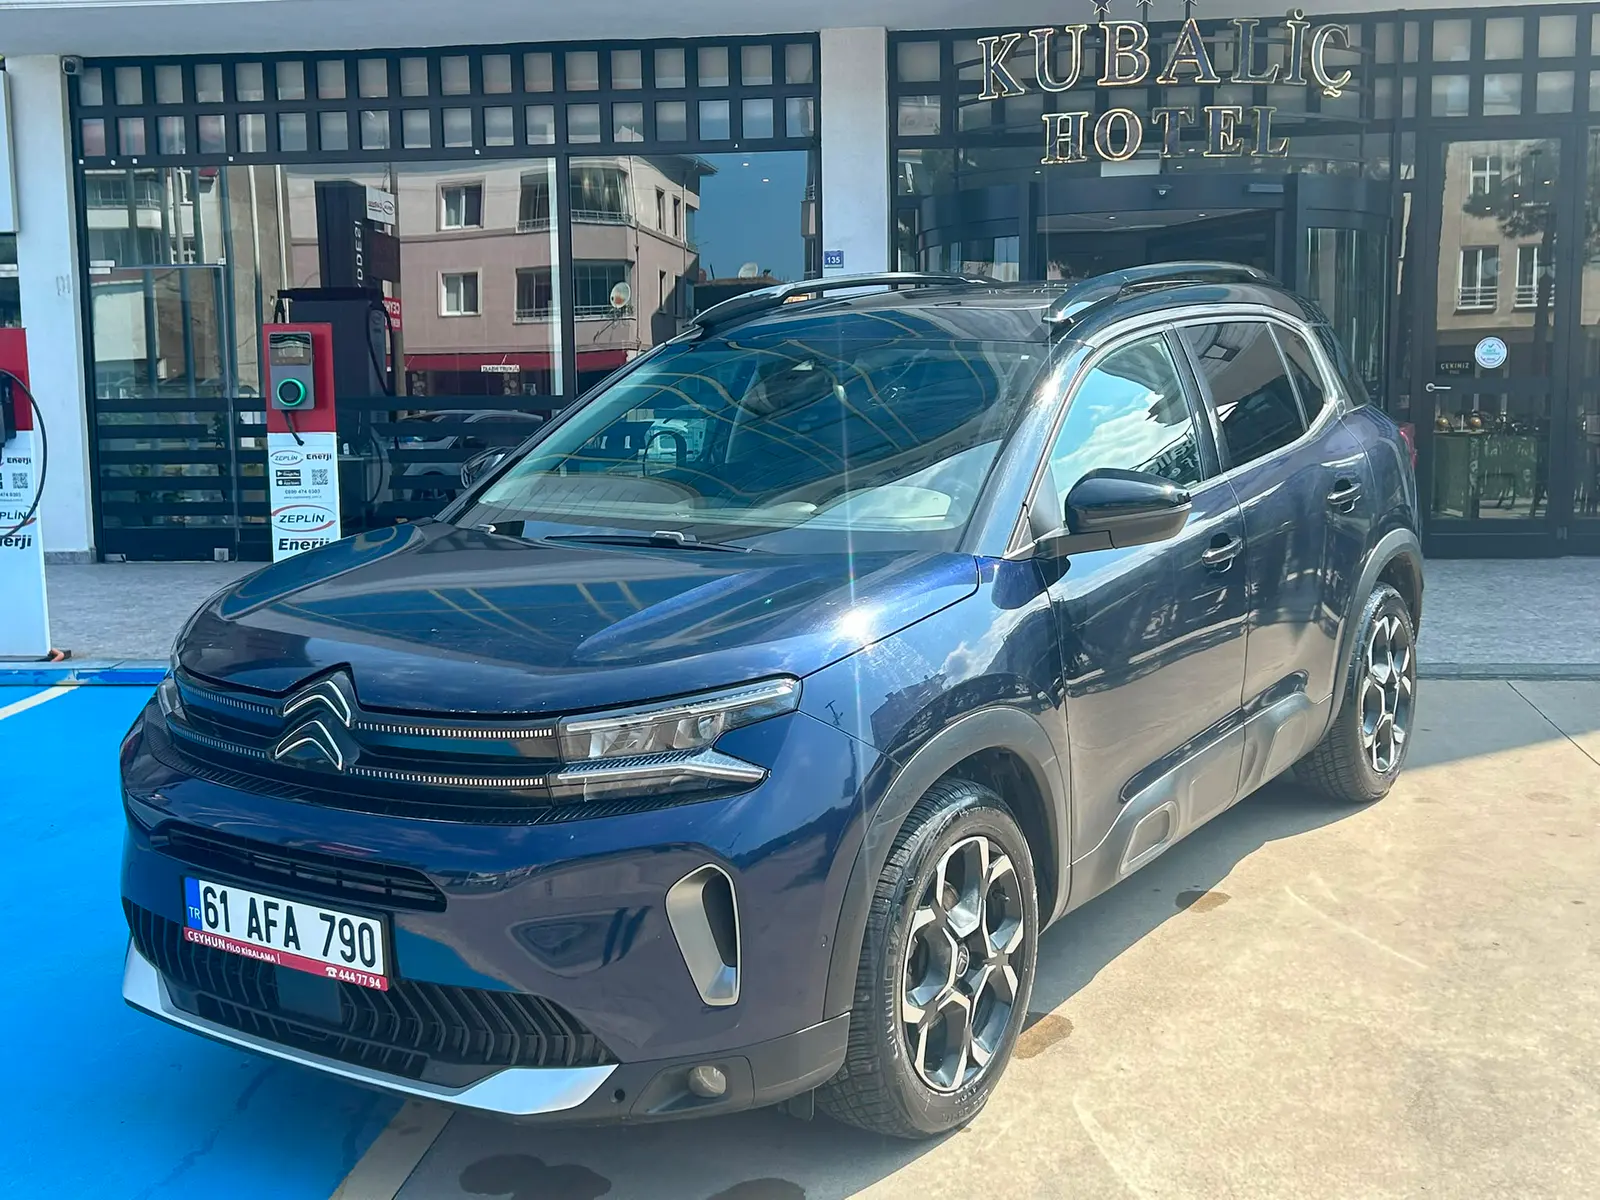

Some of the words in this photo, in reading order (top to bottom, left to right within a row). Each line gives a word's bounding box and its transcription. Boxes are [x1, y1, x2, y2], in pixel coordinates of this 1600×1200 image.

[977, 8, 1352, 99] KUBALİÇ
[1041, 105, 1290, 164] HOTEL
[827, 256, 841, 264] 135
[279, 513, 325, 523] ZEPLİN
[189, 906, 200, 919] TR
[203, 886, 230, 932] 61
[247, 897, 301, 950] AFA
[319, 912, 376, 967] 790
[187, 930, 226, 950] CEYHUN
